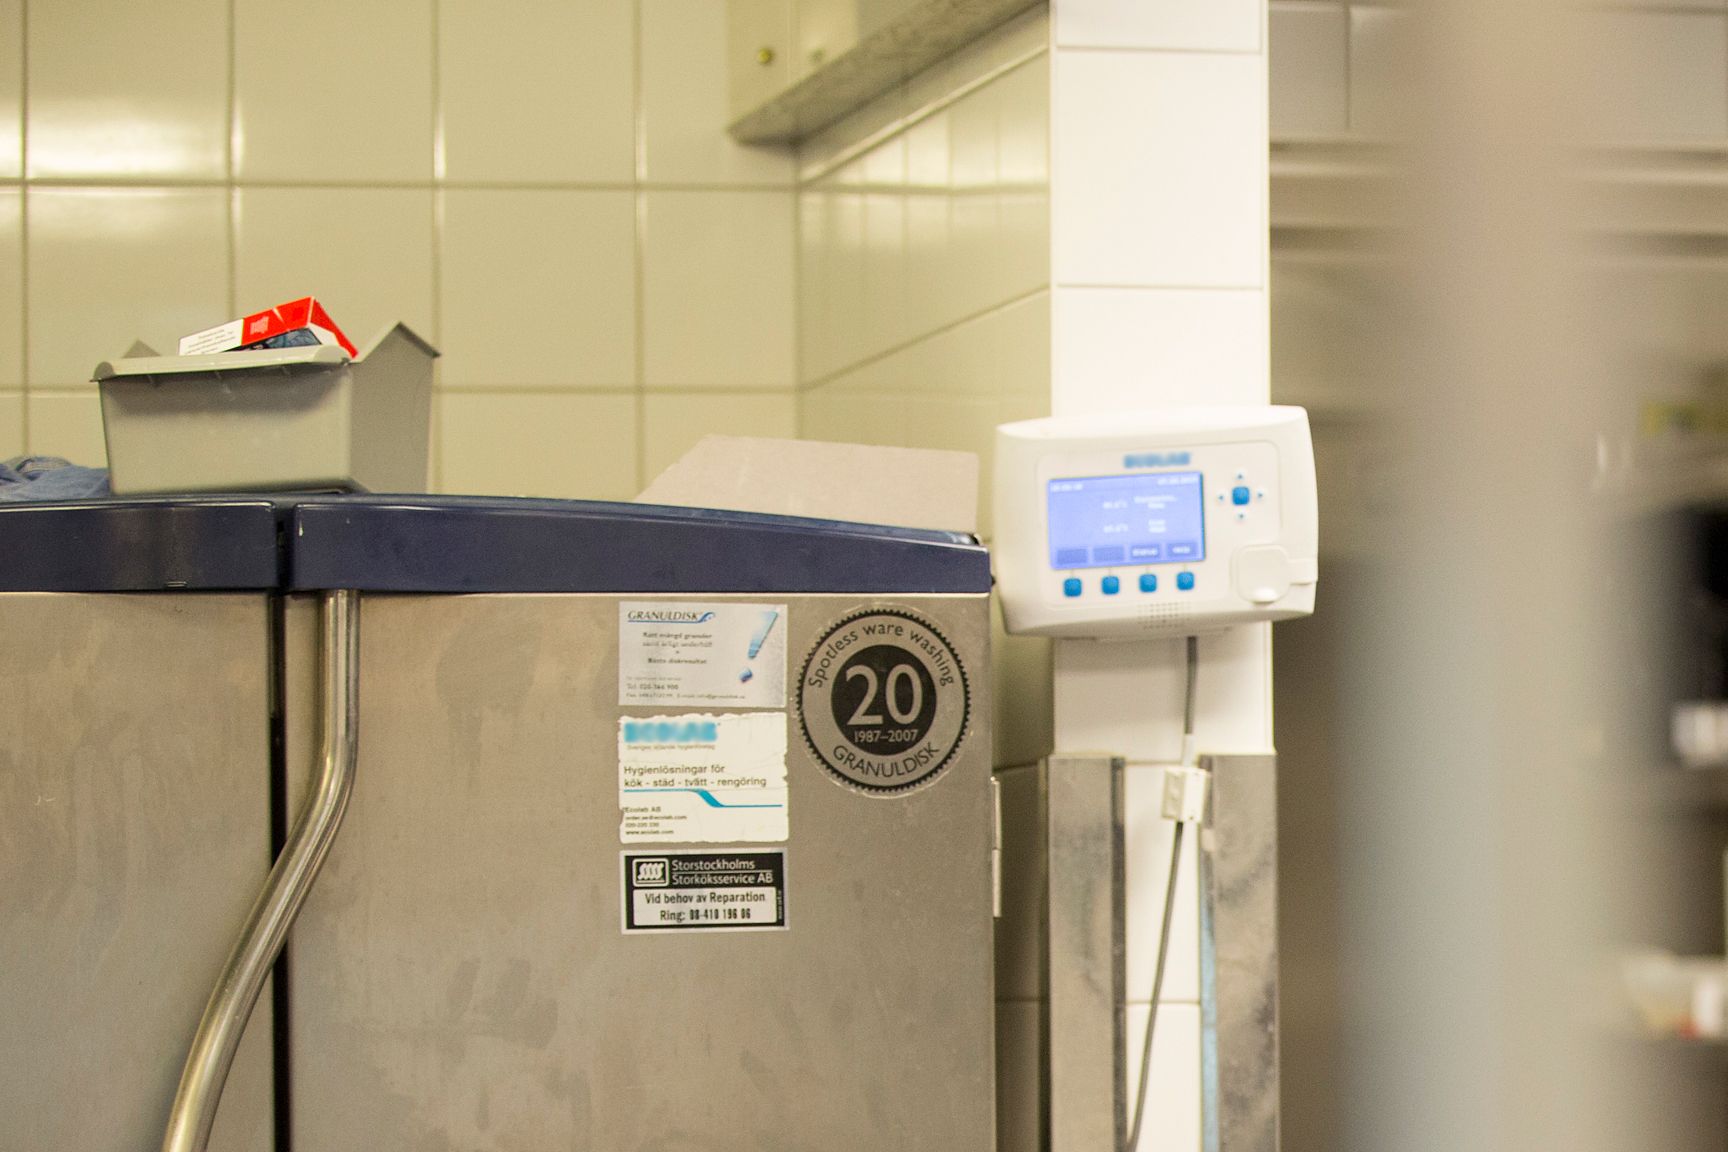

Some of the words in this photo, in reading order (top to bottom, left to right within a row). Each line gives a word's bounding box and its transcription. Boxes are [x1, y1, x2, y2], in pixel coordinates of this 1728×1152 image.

[627, 611, 698, 621] GRANULDISK
[808, 630, 859, 688] Spotless
[862, 623, 904, 636] ware
[910, 630, 955, 687] washing
[845, 663, 923, 725] 20
[832, 742, 940, 778] GRANULDISK
[624, 765, 708, 776] Hygienlösningar
[711, 764, 725, 773] för
[624, 778, 642, 787] kök
[653, 778, 675, 787] städ
[685, 777, 707, 786] tvätt
[717, 777, 767, 788] rengöring
[672, 859, 756, 871] Storstockholms
[672, 873, 756, 885] Storköksservice
[757, 872, 773, 883] AB
[645, 893, 661, 904] Vid
[664, 892, 693, 903] behov
[696, 894, 707, 903] av
[710, 892, 766, 905] Reparation
[660, 910, 685, 923] Ring:
